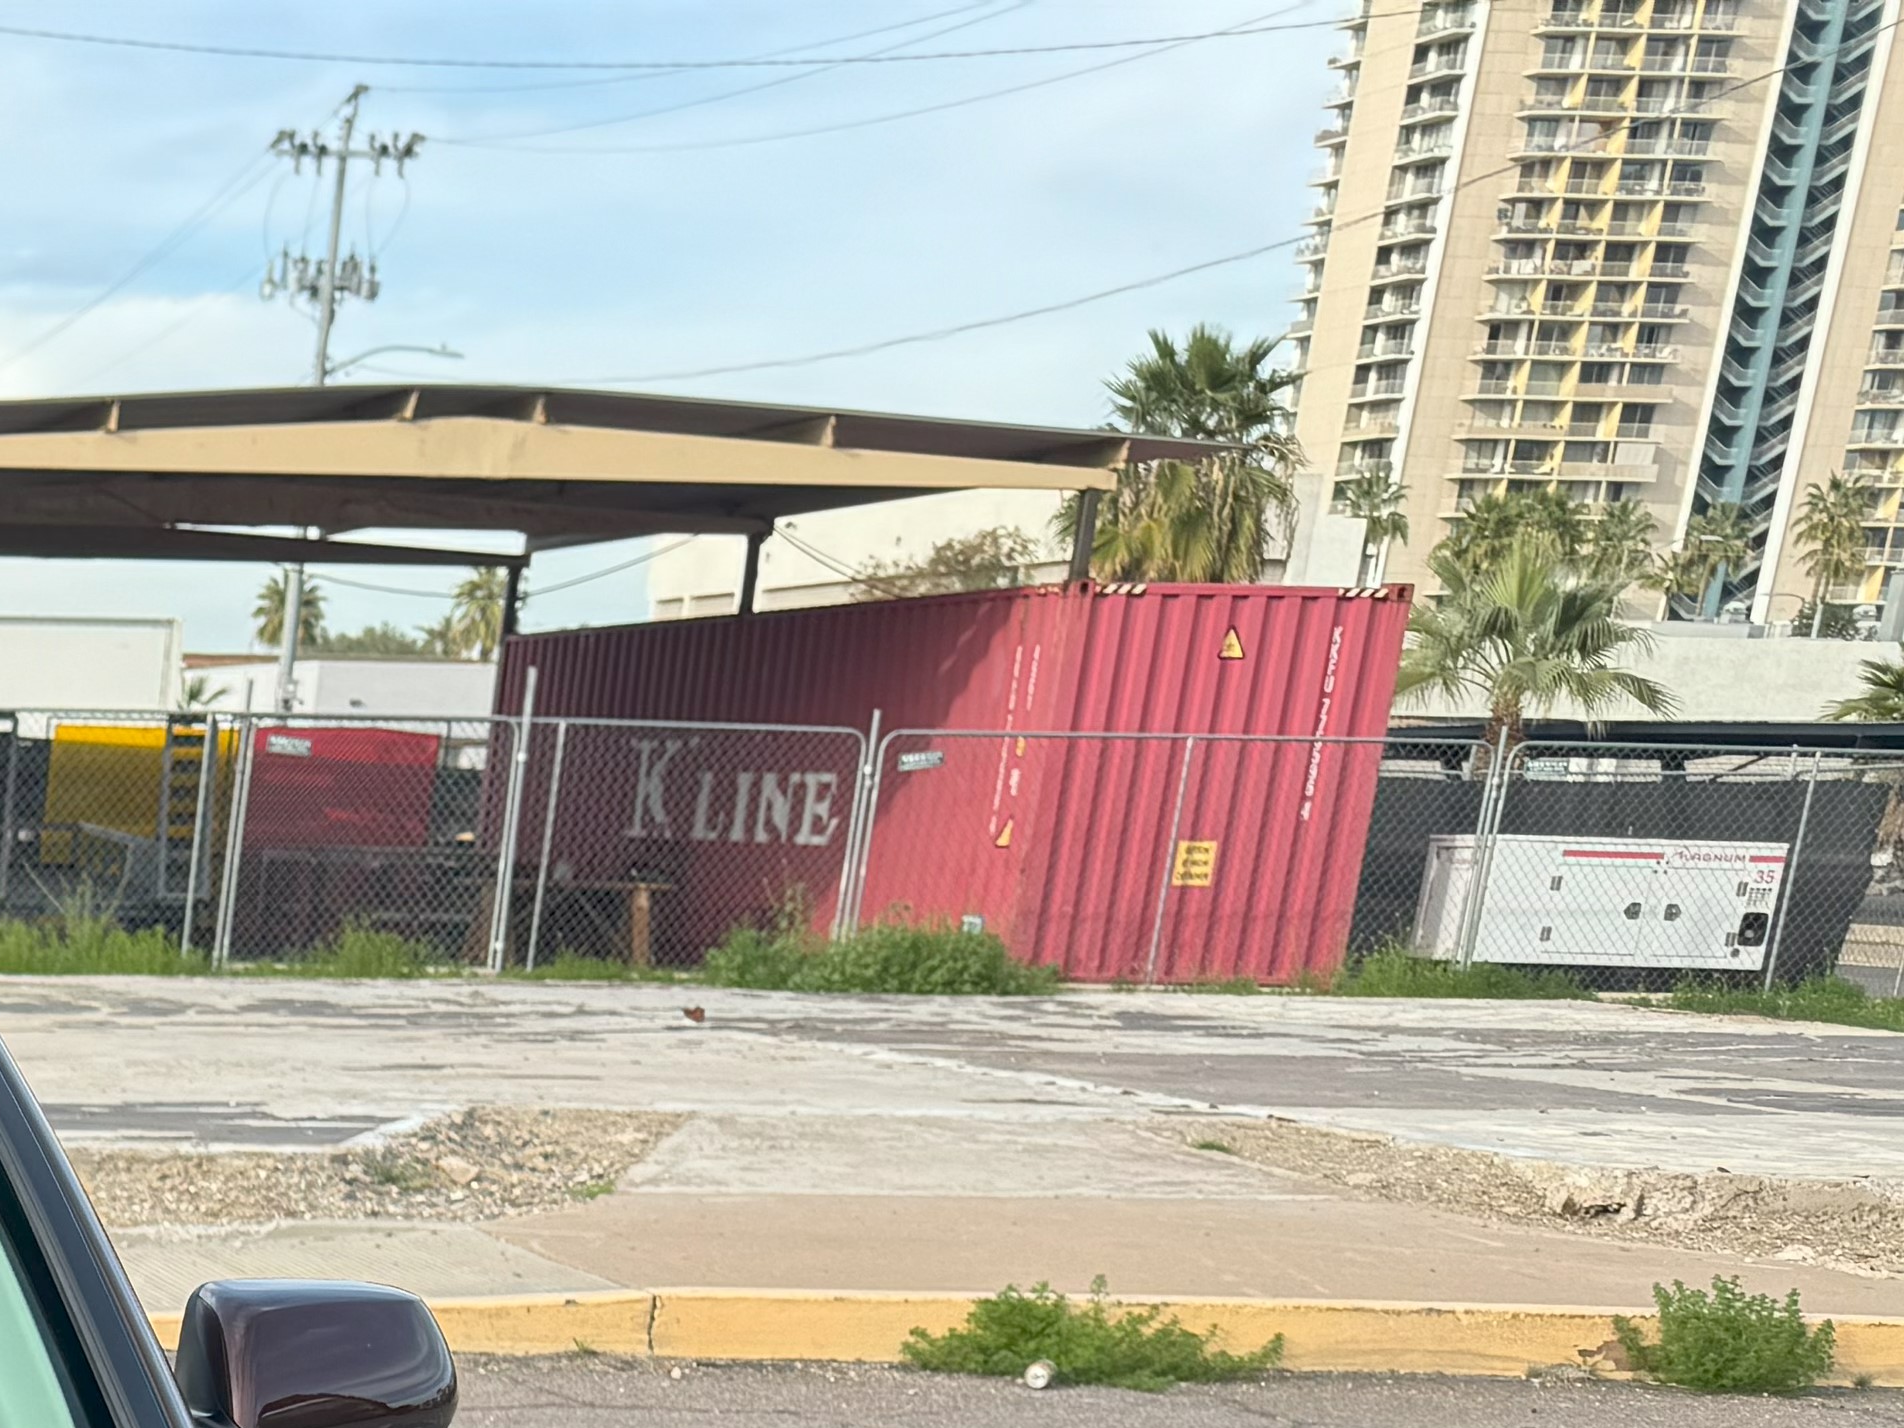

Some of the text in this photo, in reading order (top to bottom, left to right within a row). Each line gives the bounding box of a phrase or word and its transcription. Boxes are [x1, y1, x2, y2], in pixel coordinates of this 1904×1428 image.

[691, 771, 840, 846] LINE
[1672, 848, 1746, 862] MAGNUM
[1753, 869, 1775, 884] 35
